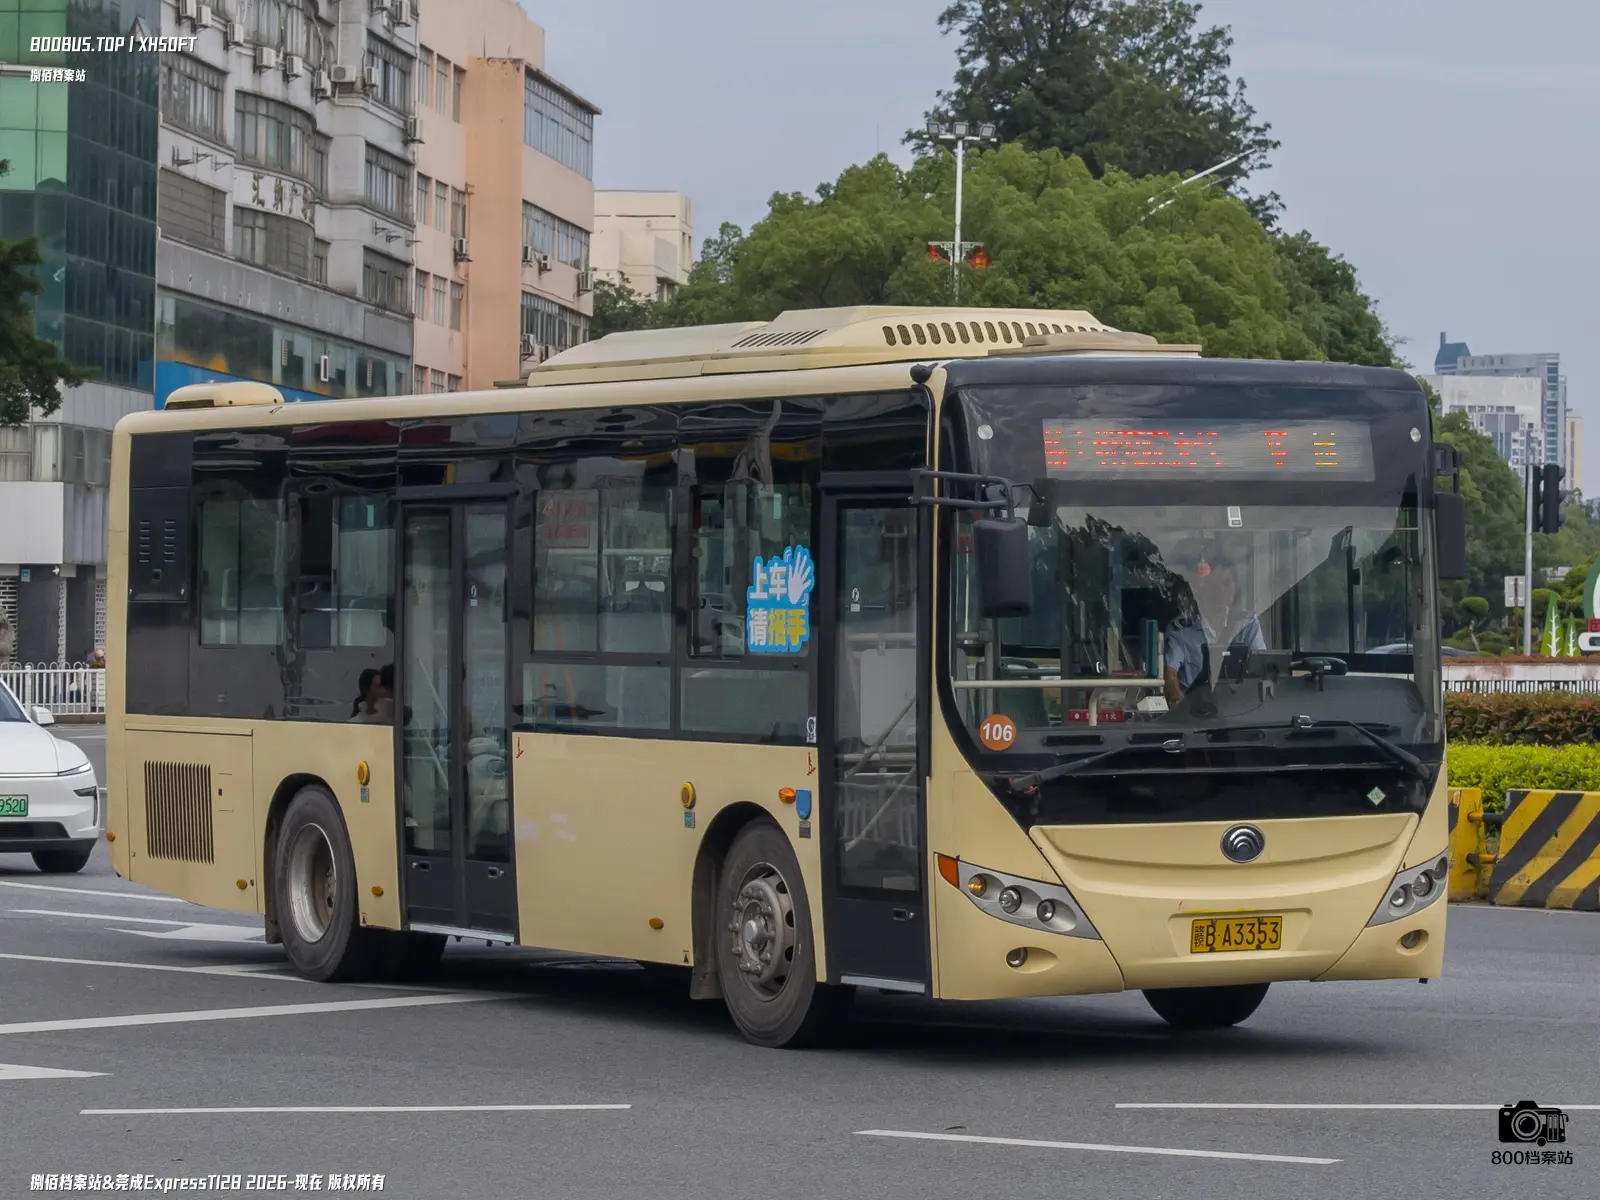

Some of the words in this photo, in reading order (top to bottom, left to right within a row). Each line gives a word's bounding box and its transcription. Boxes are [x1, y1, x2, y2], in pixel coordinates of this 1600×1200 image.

[749, 562, 788, 601] 上车
[749, 607, 807, 646] 请招手
[983, 723, 1012, 742] 106
